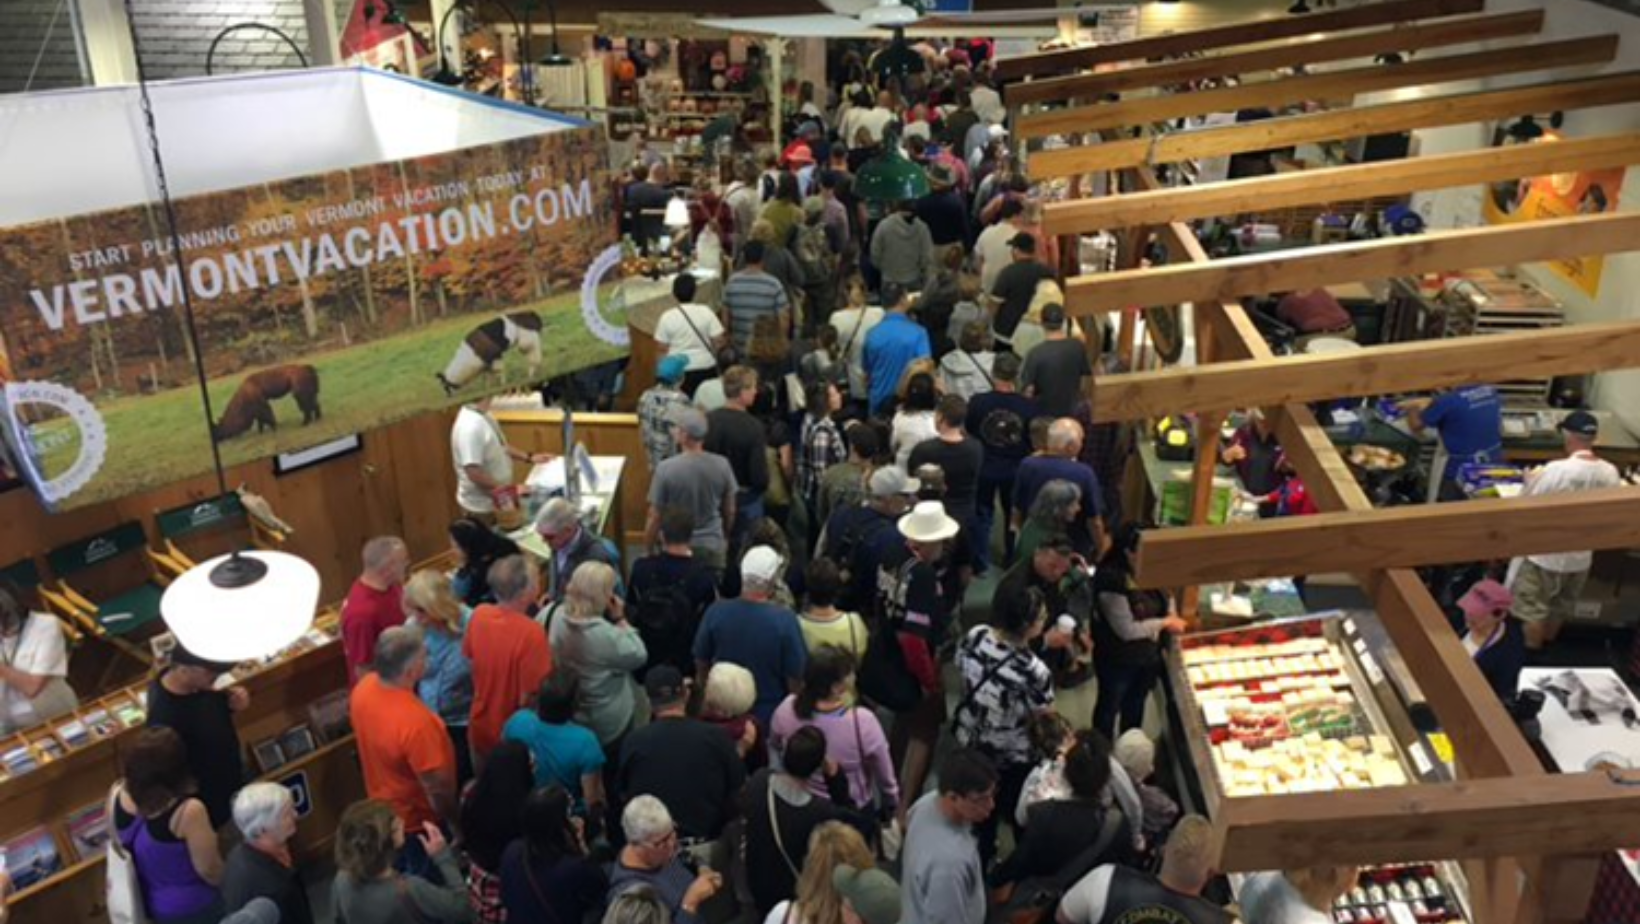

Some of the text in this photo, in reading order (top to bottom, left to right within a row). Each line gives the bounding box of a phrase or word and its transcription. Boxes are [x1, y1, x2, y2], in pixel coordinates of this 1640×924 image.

[30, 178, 593, 331] VERMONTVACATION.COM
[70, 164, 547, 271] START PLANNING YOUR VERMONT VACATION TODAY AT
